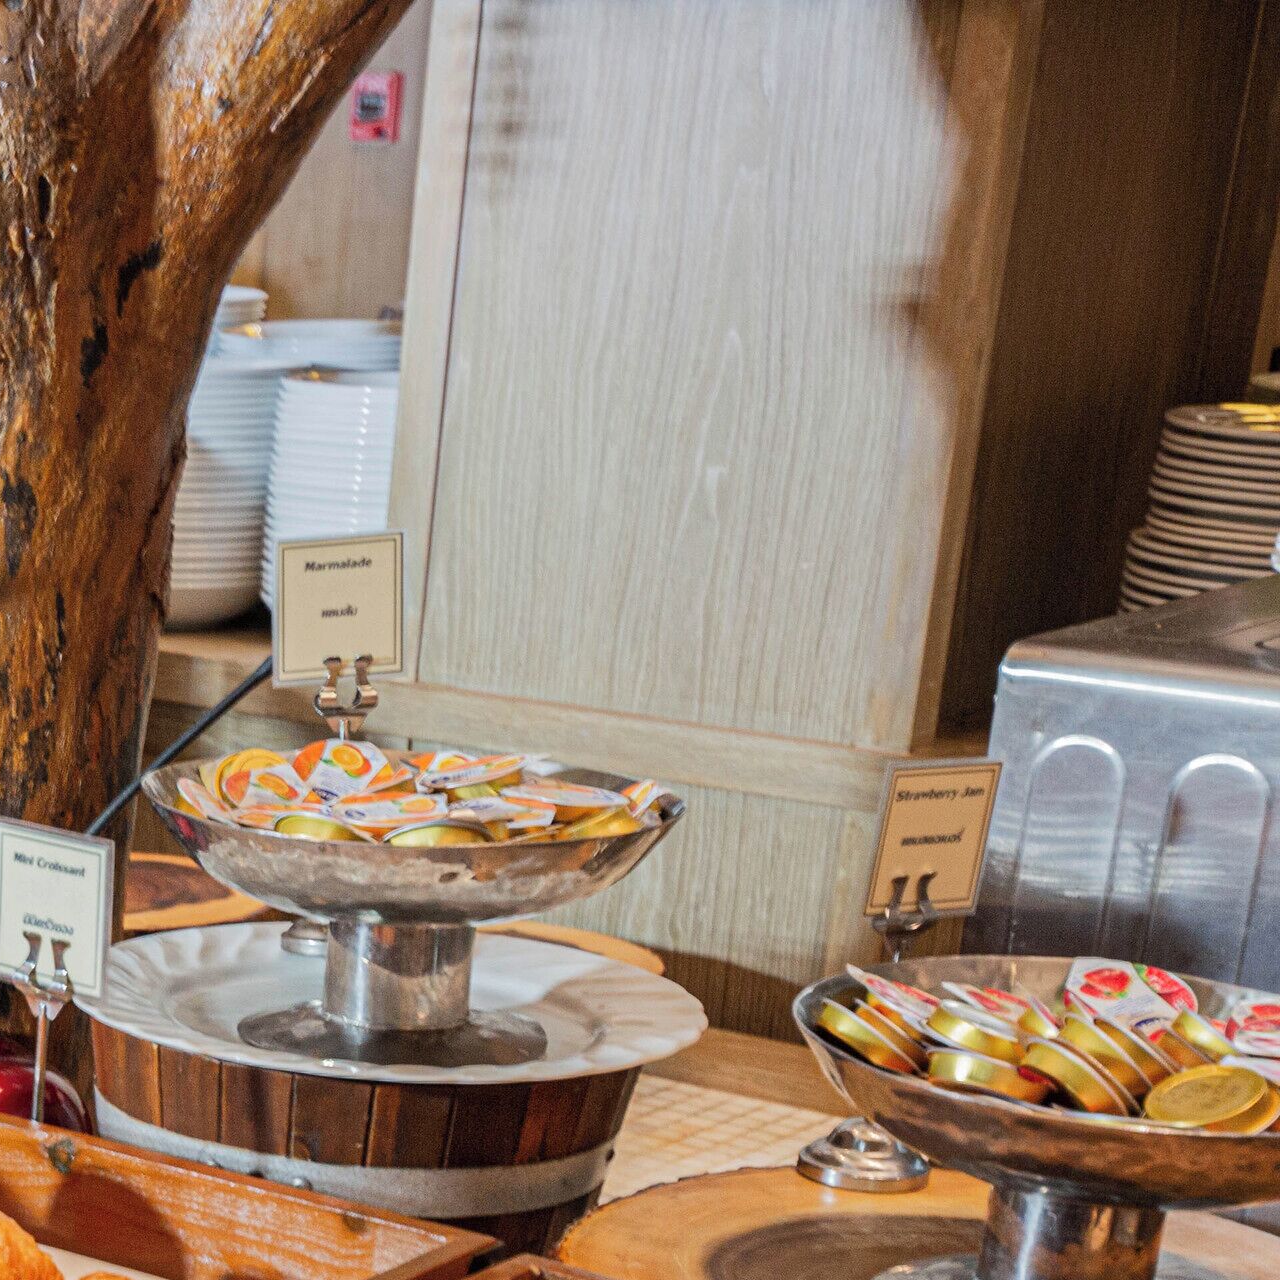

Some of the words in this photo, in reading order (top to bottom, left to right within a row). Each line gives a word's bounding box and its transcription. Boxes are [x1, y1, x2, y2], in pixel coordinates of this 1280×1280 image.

[304, 556, 373, 572] Marmalade
[896, 788, 959, 802] Strawberry
[960, 785, 985, 799] Jam
[13, 852, 35, 865] Mini
[37, 856, 86, 878] Croissant
